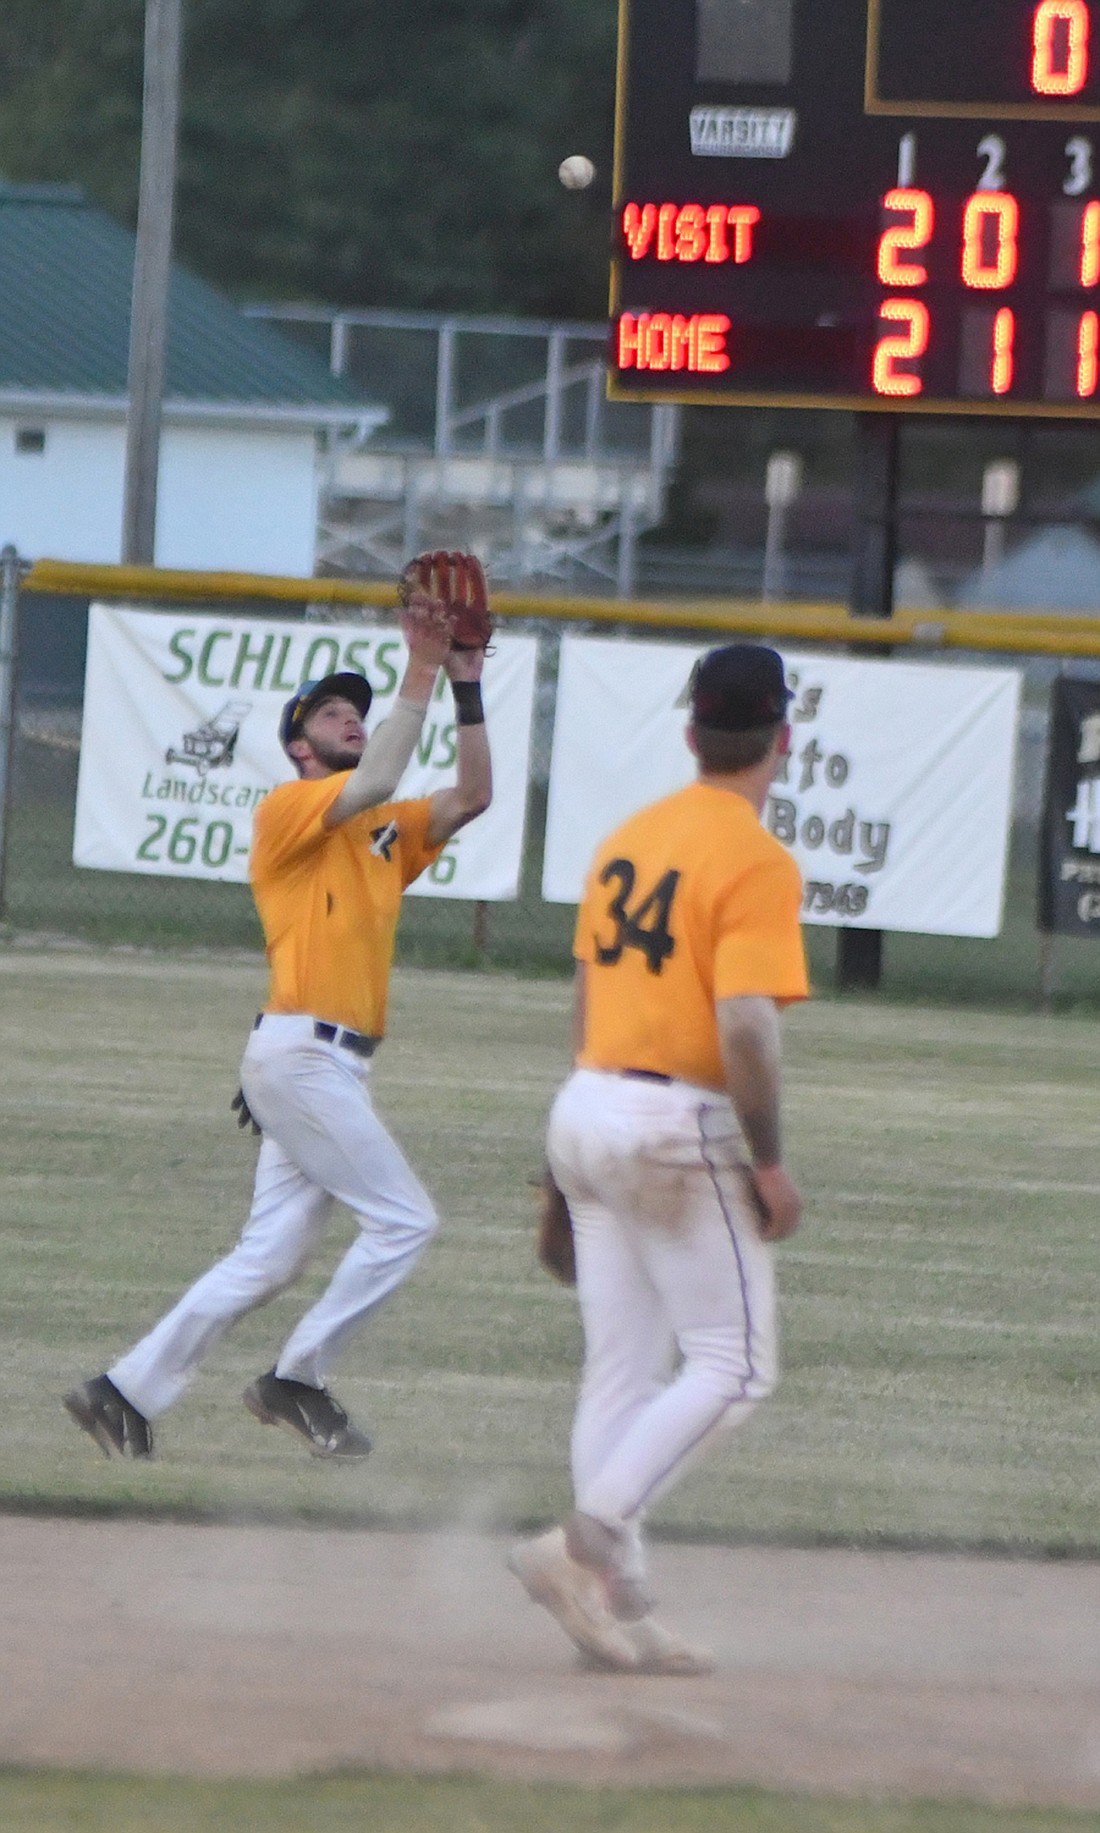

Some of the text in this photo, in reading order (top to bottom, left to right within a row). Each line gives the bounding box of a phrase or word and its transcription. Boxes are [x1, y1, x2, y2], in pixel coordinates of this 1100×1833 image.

[1033, 0, 1089, 94] 0
[691, 108, 795, 156] VARSITY
[897, 132, 1093, 196] 1 2 3
[623, 188, 1100, 289] VISIT 2 0 1
[618, 298, 1100, 396] HOME 2 1 1
[767, 796, 891, 874] Body
[592, 857, 680, 976] 34
